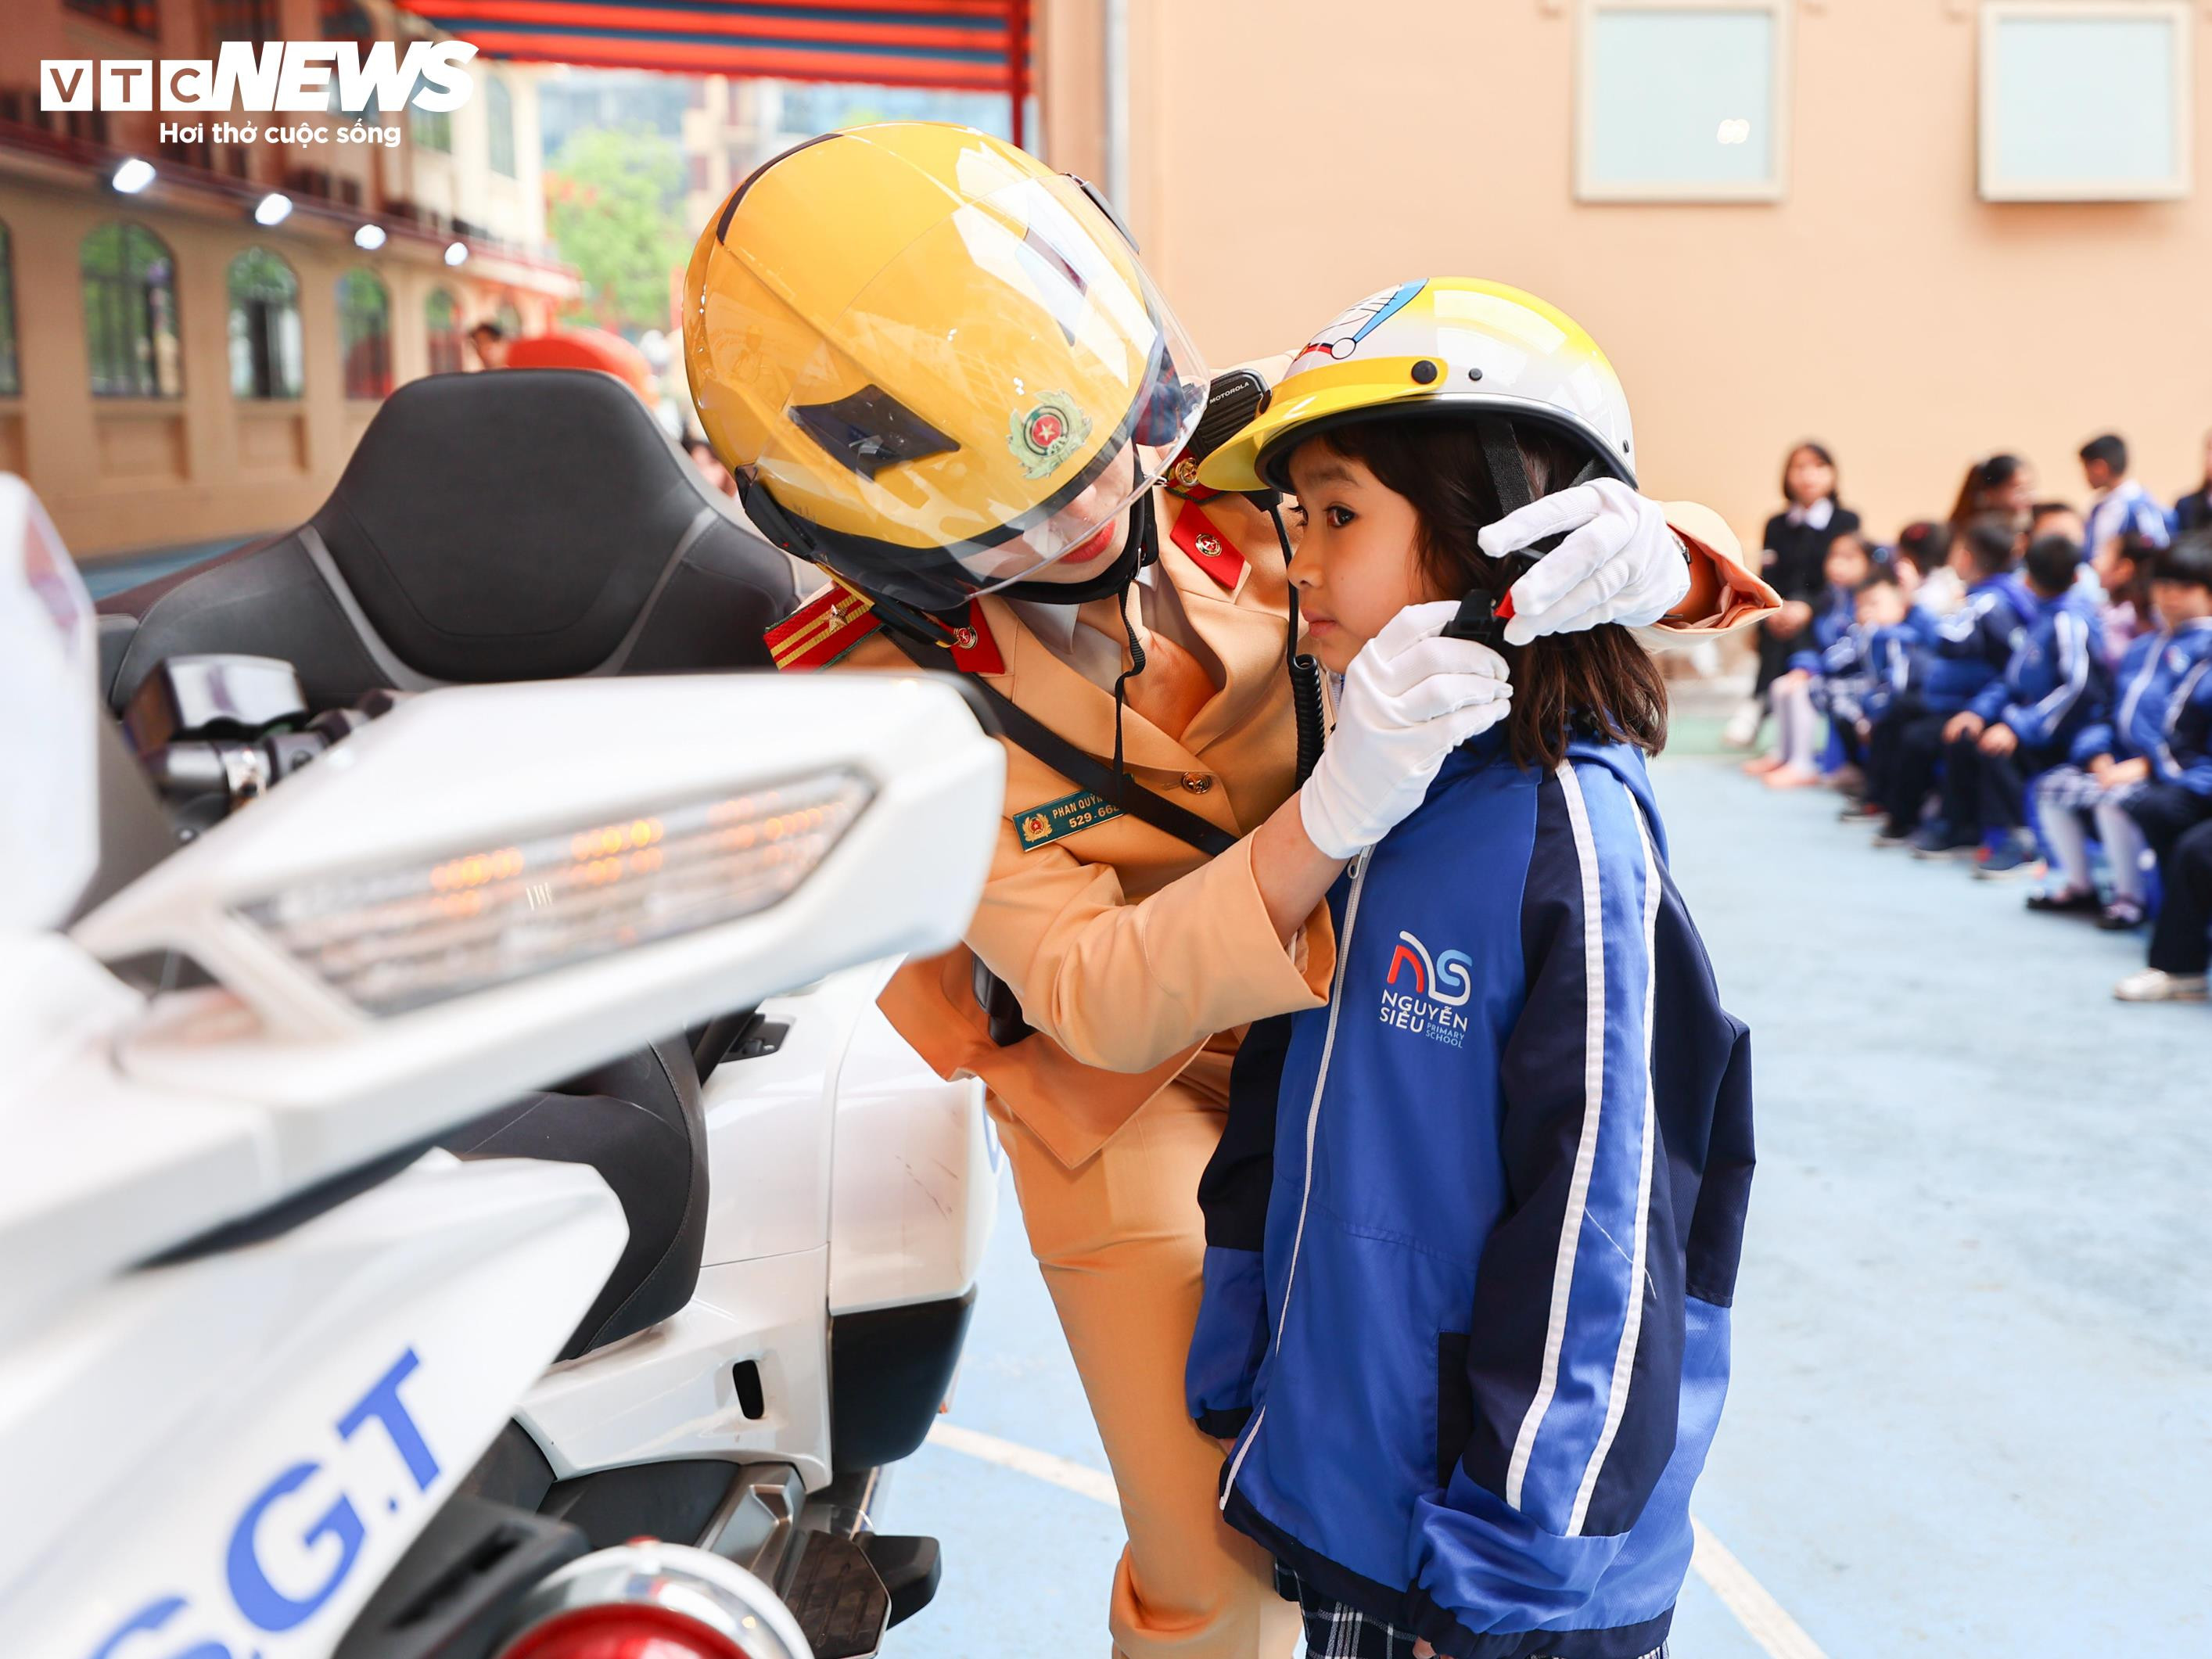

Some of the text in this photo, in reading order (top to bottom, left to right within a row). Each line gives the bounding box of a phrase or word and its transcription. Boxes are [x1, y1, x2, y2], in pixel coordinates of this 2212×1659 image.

[1209, 381, 1250, 404] MOTOROLA
[1052, 802, 1078, 819] PHAN
[1381, 989, 1468, 1032] NGUYỄN
[1426, 1030, 1463, 1049] SCHOOL
[1427, 1022, 1465, 1040] PRIMARY
